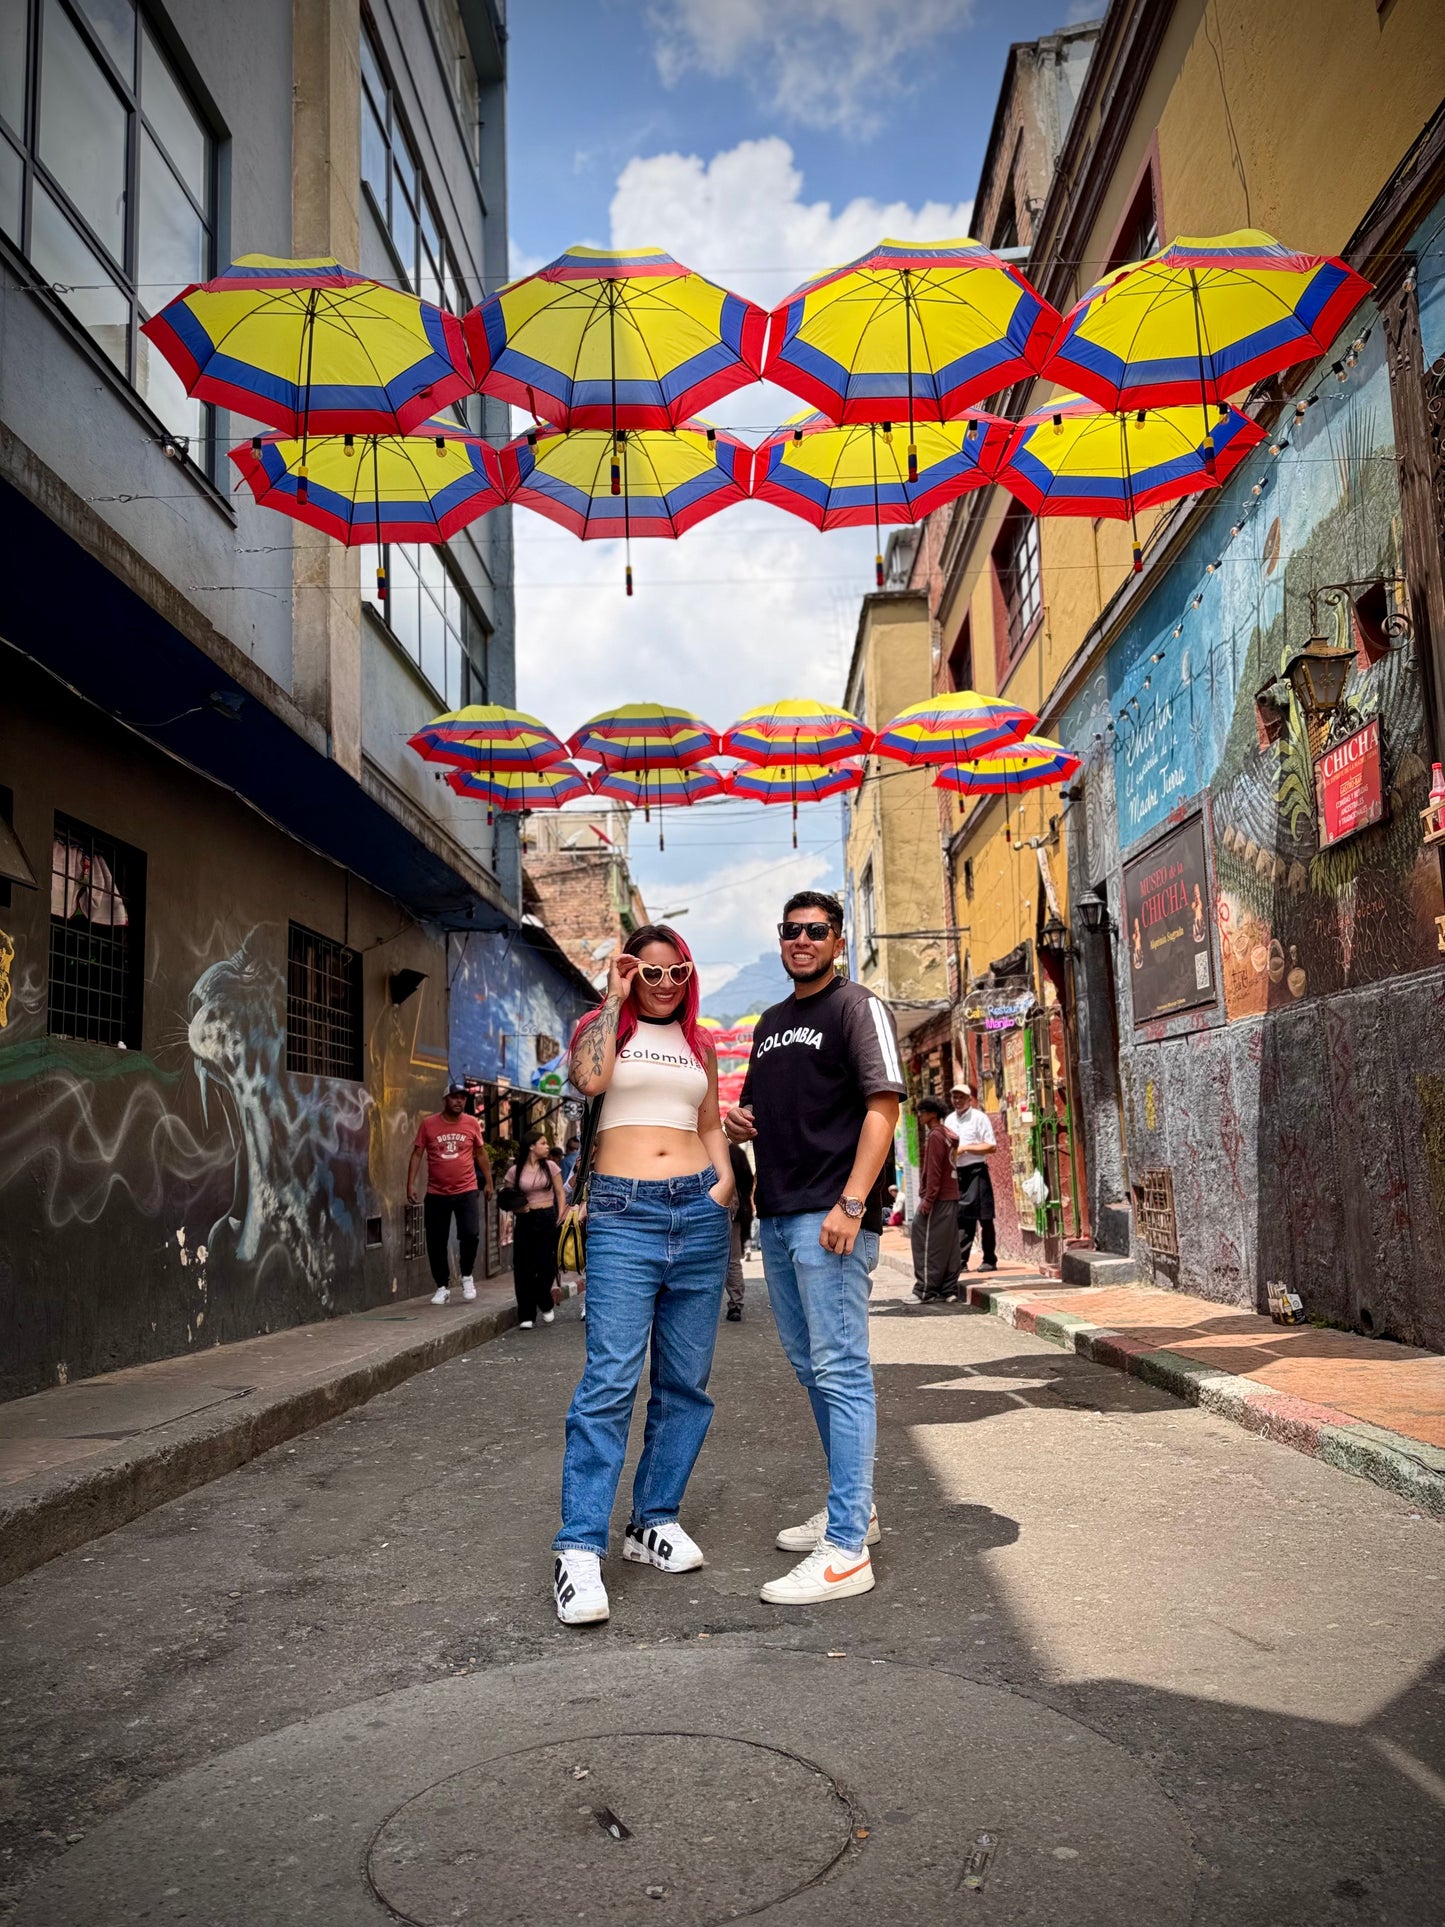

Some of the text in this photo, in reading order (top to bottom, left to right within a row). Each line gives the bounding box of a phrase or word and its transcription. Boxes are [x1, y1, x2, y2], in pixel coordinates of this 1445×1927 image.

[1324, 726, 1379, 778] CHICHA
[1129, 781, 1159, 827] Madre
[1140, 865, 1168, 897] MUSEO
[1141, 880, 1189, 929] CHICHA
[757, 1027, 823, 1058] COLOMBIA
[570, 1103, 578, 1115] 3
[436, 1133, 467, 1143] BOSTON
